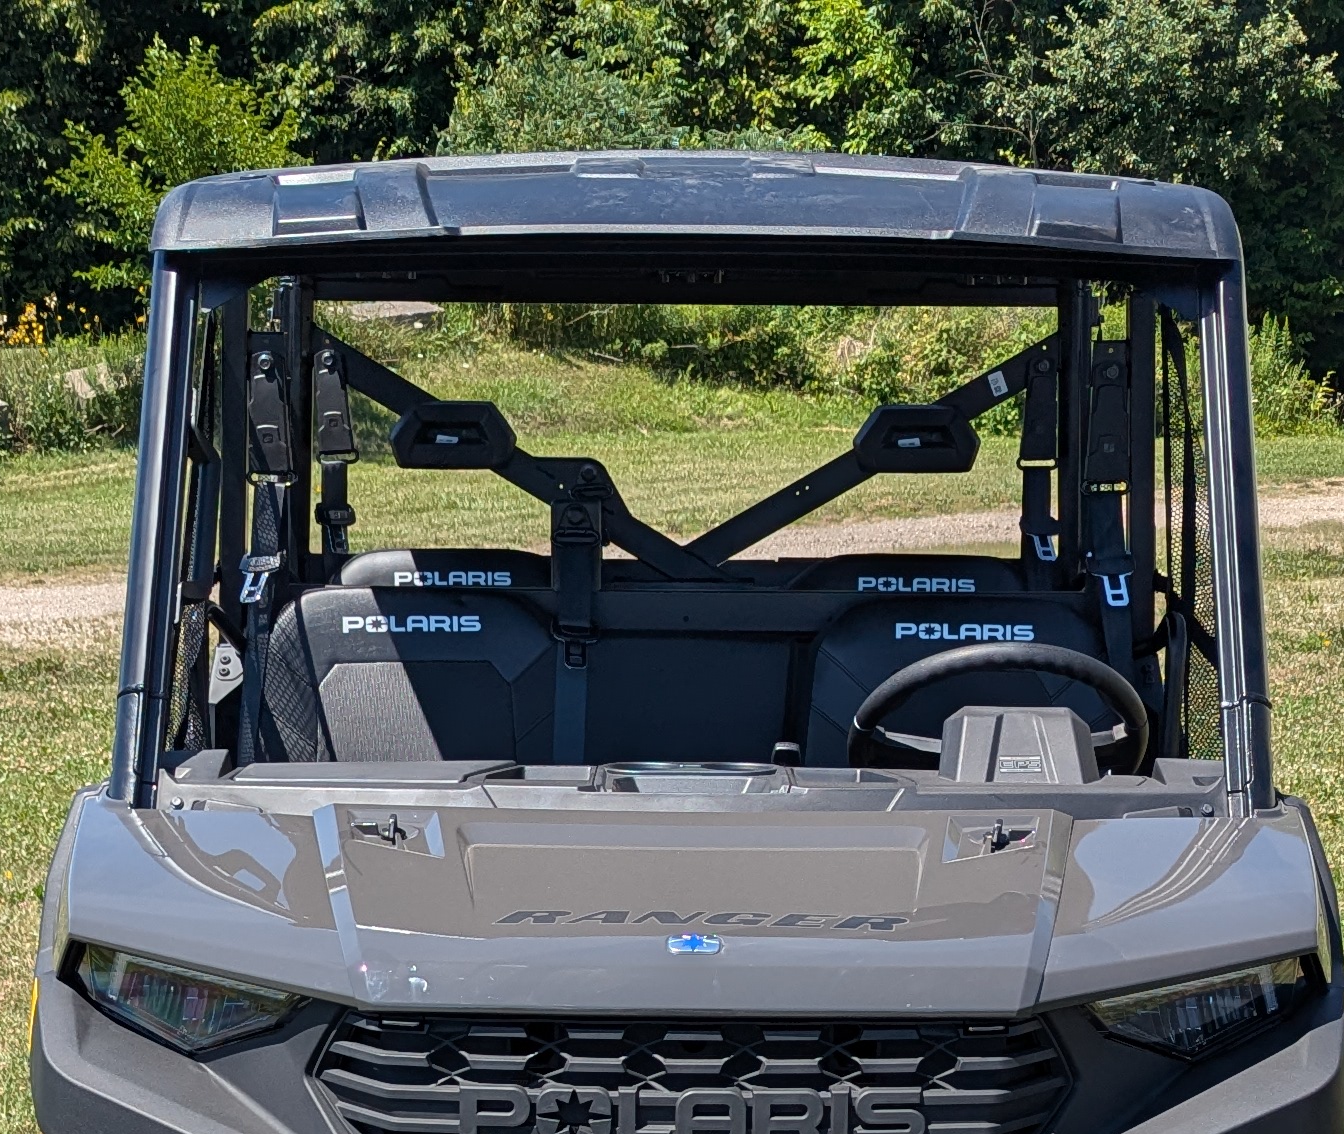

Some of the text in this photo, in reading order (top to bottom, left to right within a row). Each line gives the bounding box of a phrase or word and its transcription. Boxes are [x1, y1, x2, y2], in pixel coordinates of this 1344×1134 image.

[394, 571, 512, 586] POLARIS
[858, 576, 976, 592] POLARIS
[342, 615, 482, 634] POLARIS
[895, 622, 1035, 641] POLARIS
[492, 910, 910, 932] RANGER
